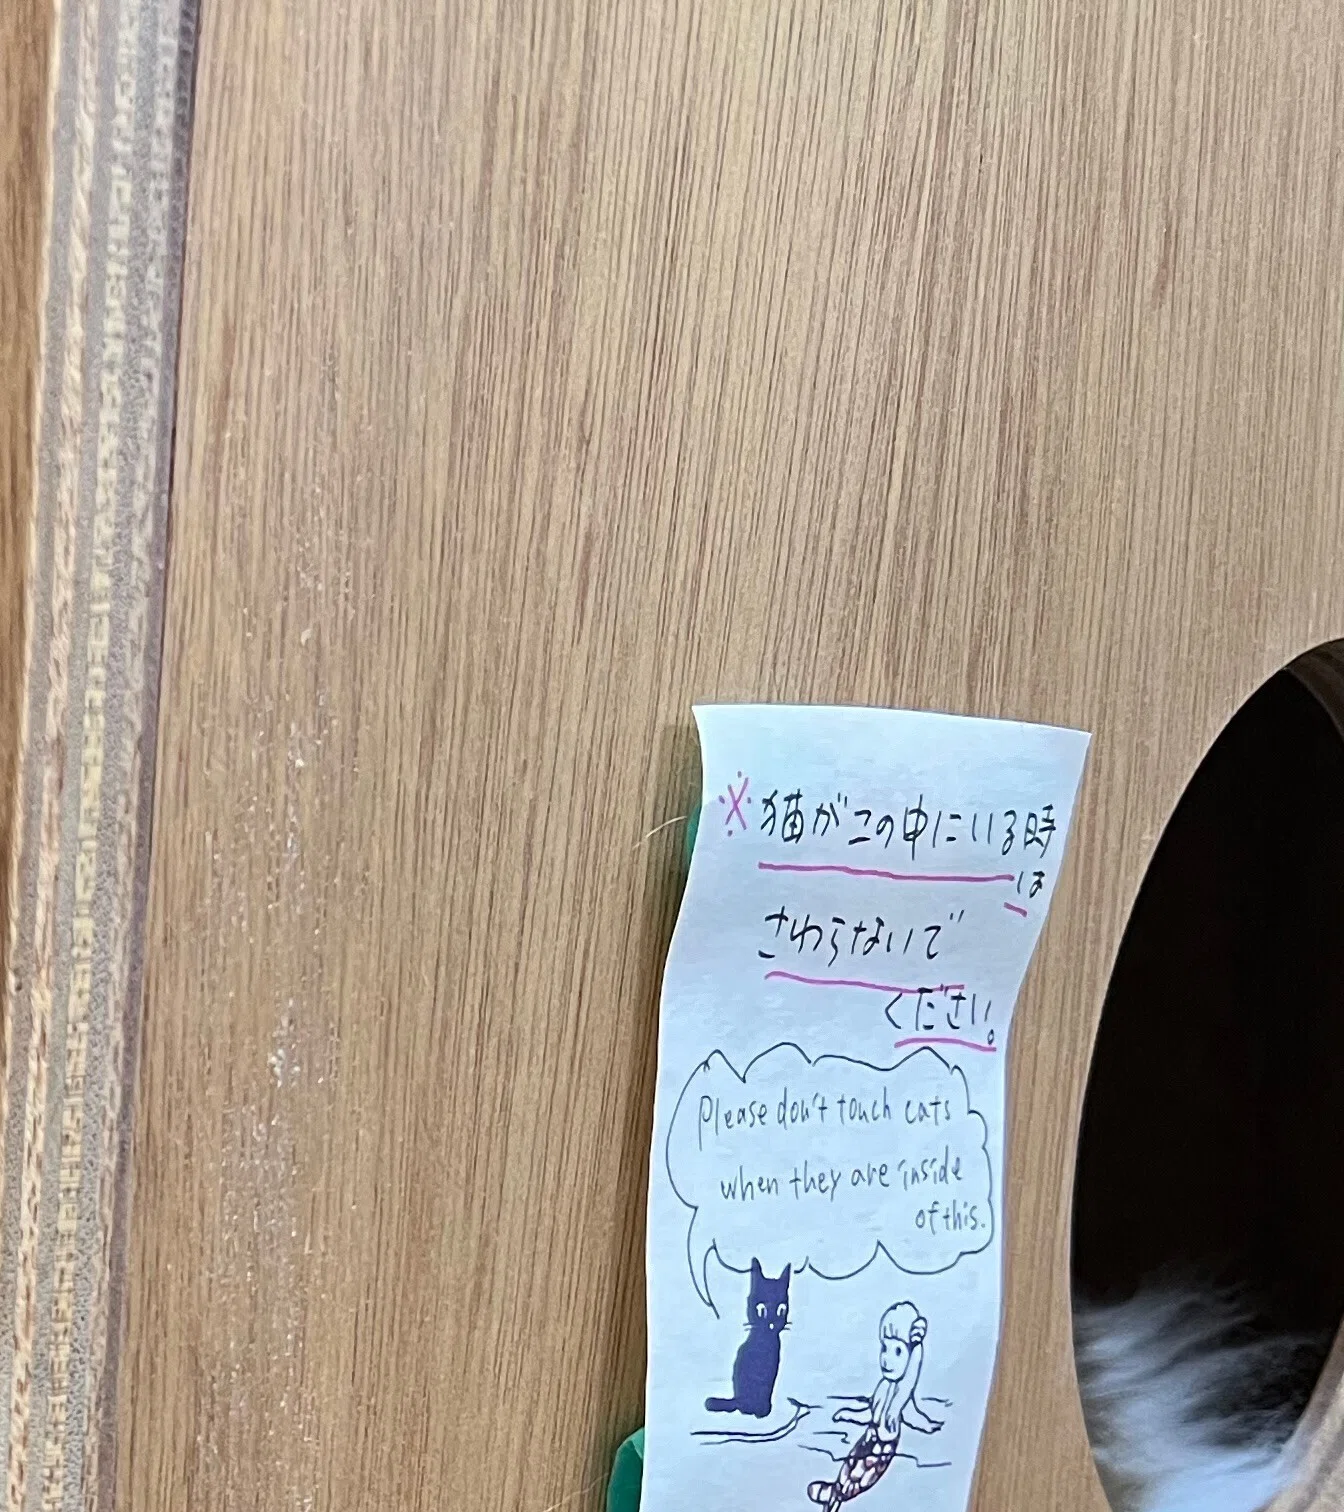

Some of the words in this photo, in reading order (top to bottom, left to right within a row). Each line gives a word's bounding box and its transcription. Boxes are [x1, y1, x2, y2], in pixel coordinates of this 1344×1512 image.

[758, 904, 965, 968] さわらないで
[775, 1086, 829, 1124] don't
[835, 1085, 893, 1122] touch
[904, 1095, 953, 1124] cats
[719, 1164, 781, 1202] when
[788, 1159, 843, 1198] they
[850, 1163, 890, 1191] are
[897, 1145, 966, 1191] inside
[915, 1198, 943, 1231] of
